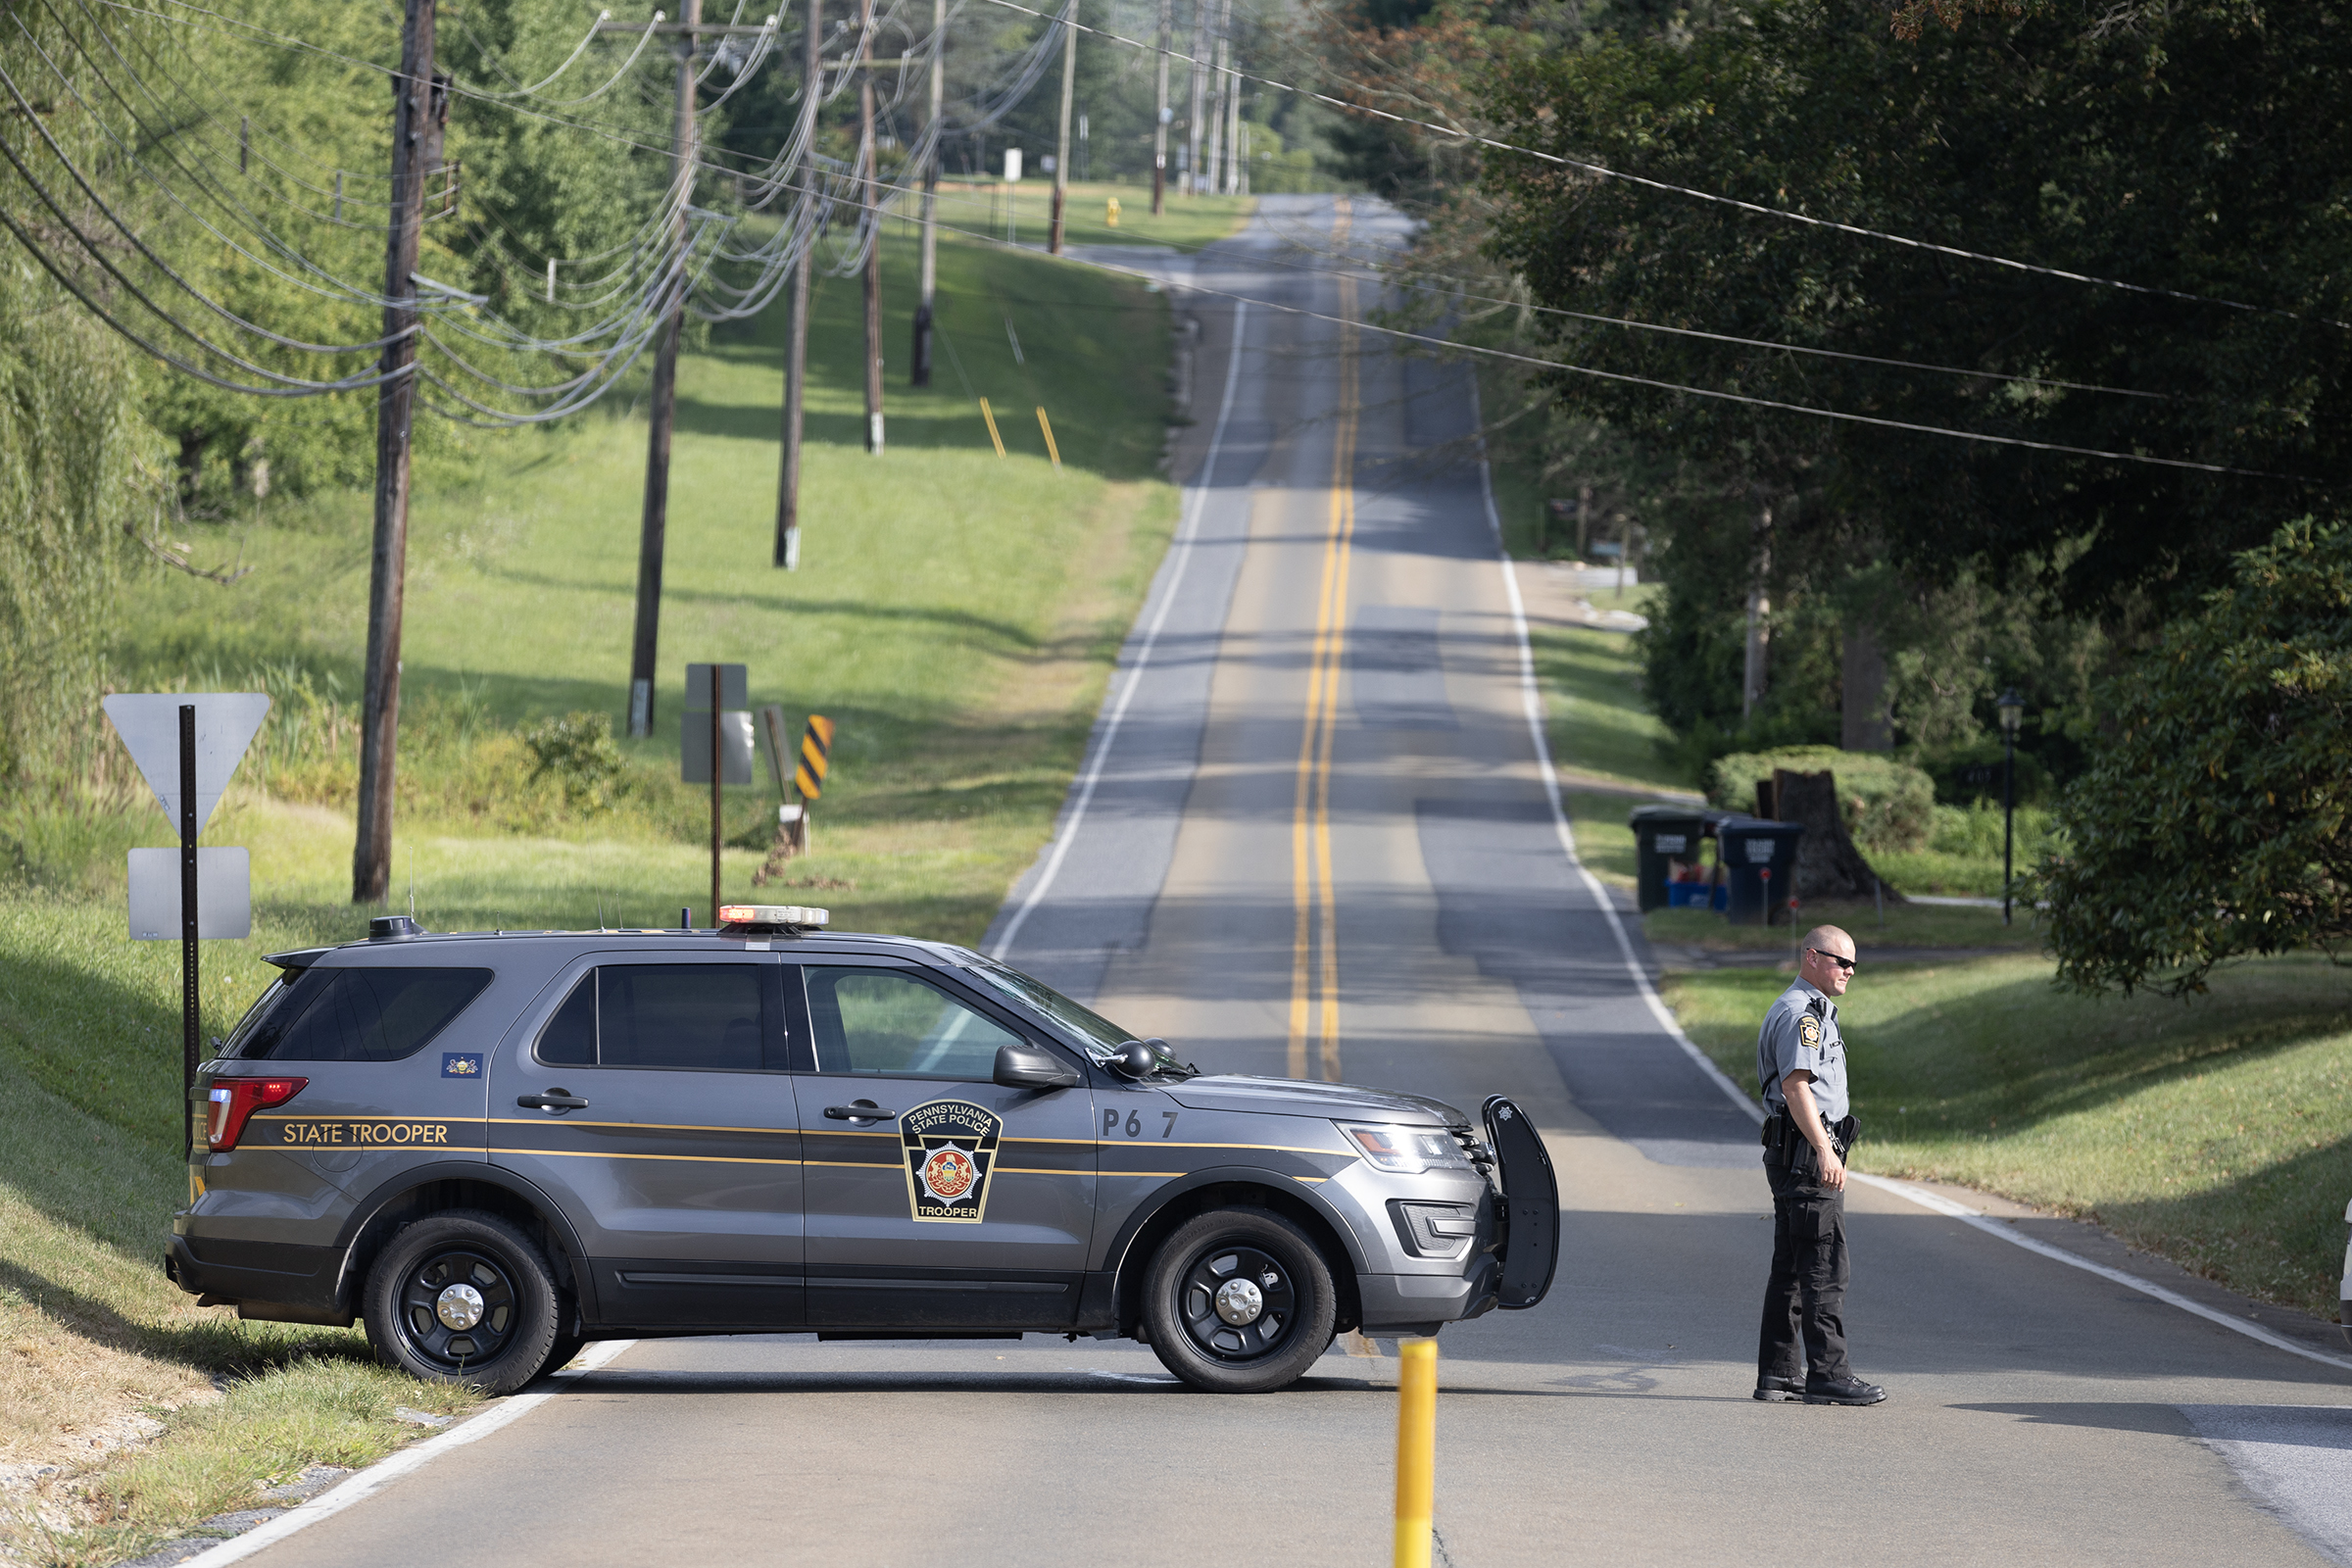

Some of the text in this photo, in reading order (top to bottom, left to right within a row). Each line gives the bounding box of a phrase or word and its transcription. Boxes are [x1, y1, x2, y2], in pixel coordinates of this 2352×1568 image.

[908, 1104, 993, 1128] PENNSYLVANIA
[911, 1114, 990, 1137] STATE POLICE
[283, 1124, 448, 1143] STATE TROOPER
[919, 1206, 977, 1217] TROOPER
